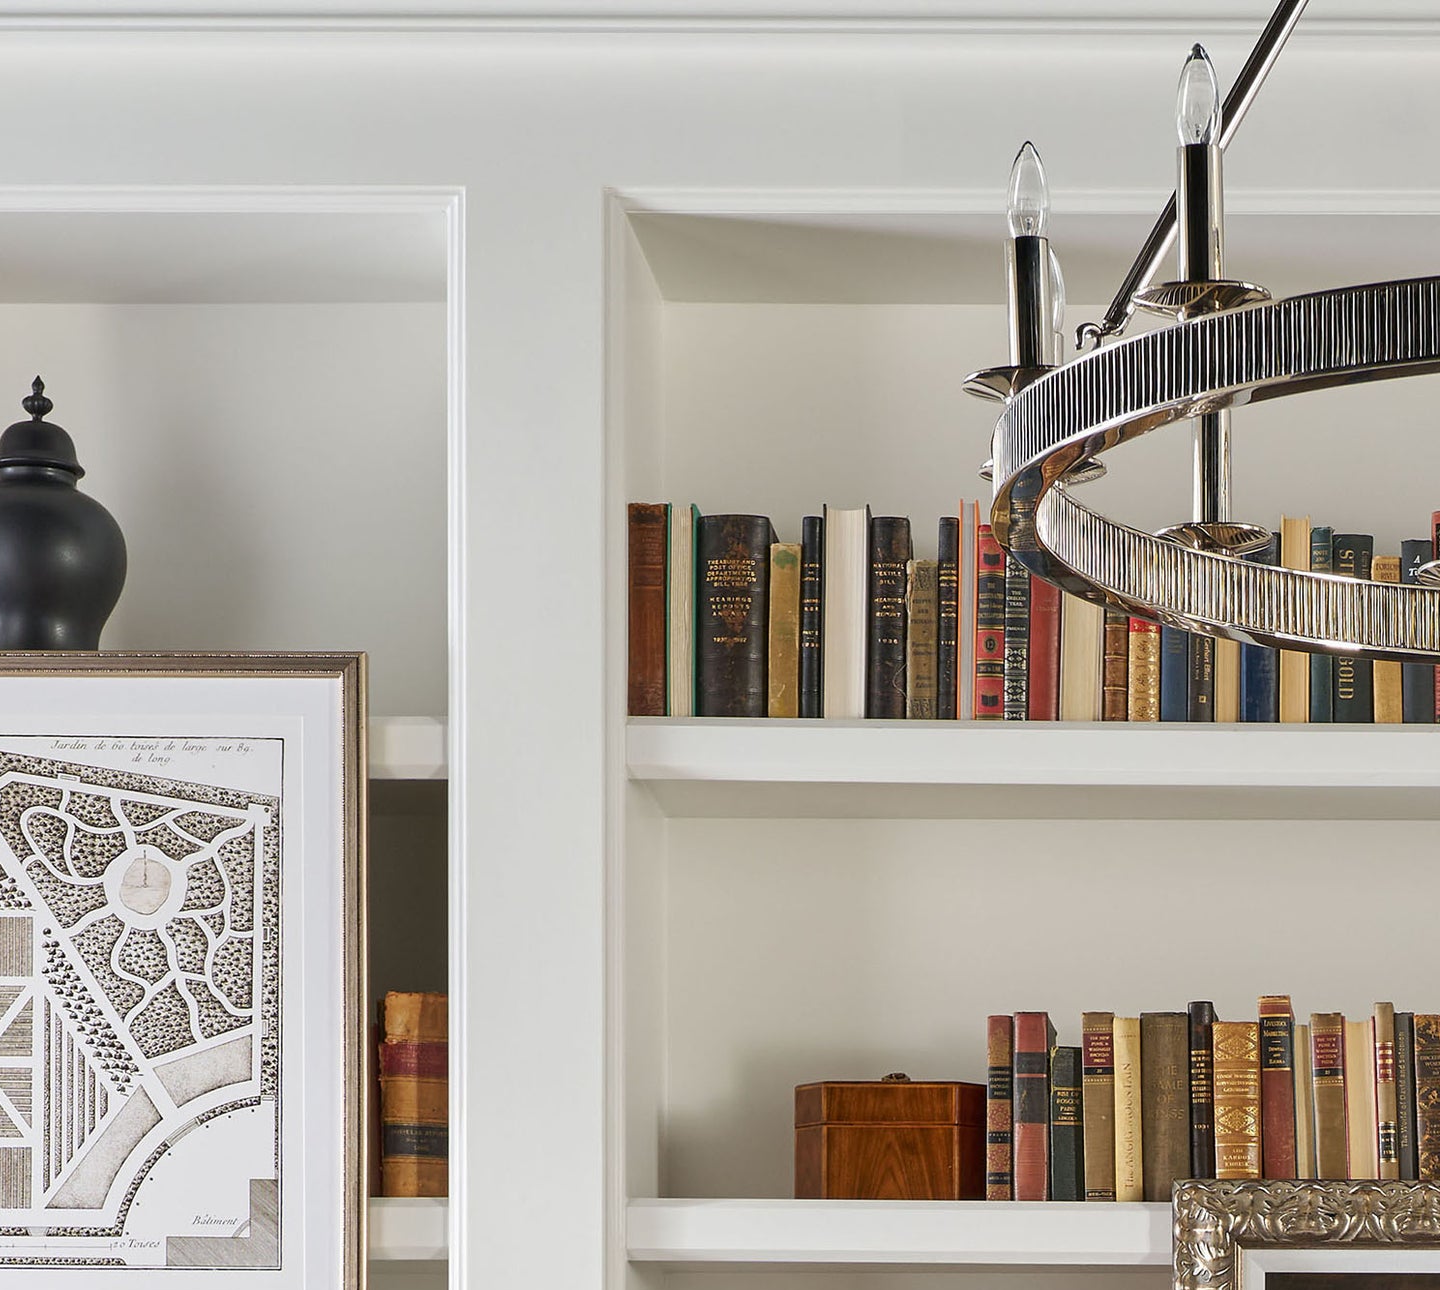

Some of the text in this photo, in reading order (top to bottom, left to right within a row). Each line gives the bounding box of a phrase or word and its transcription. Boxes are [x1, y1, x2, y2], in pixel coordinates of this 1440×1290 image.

[50, 741, 88, 752] Jardin
[95, 741, 107, 751] de
[164, 741, 176, 752] de
[181, 741, 208, 756] large
[131, 753, 144, 763] de
[1124, 1130, 1134, 1168] ANGRY
